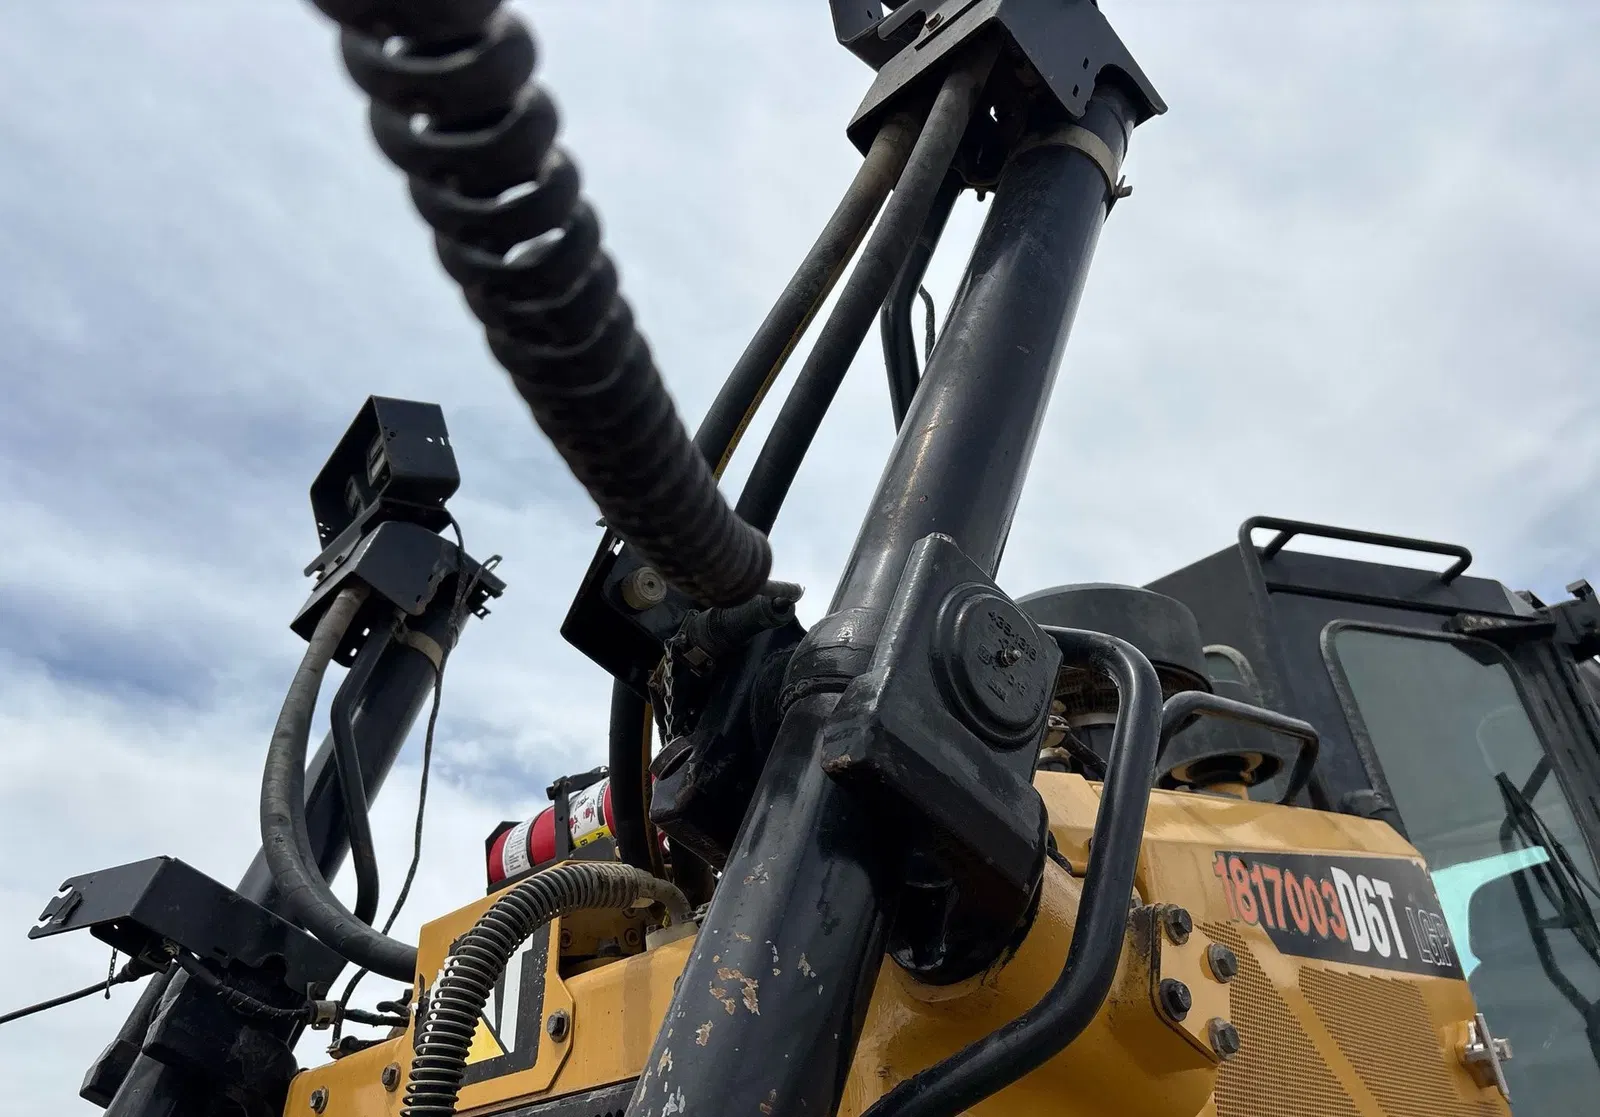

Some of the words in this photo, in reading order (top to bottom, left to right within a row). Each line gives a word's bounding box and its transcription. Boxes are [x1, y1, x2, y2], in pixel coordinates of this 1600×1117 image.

[1212, 854, 1348, 943] 1817003
[1330, 866, 1409, 960] D6T
[1404, 906, 1453, 967] LGP
